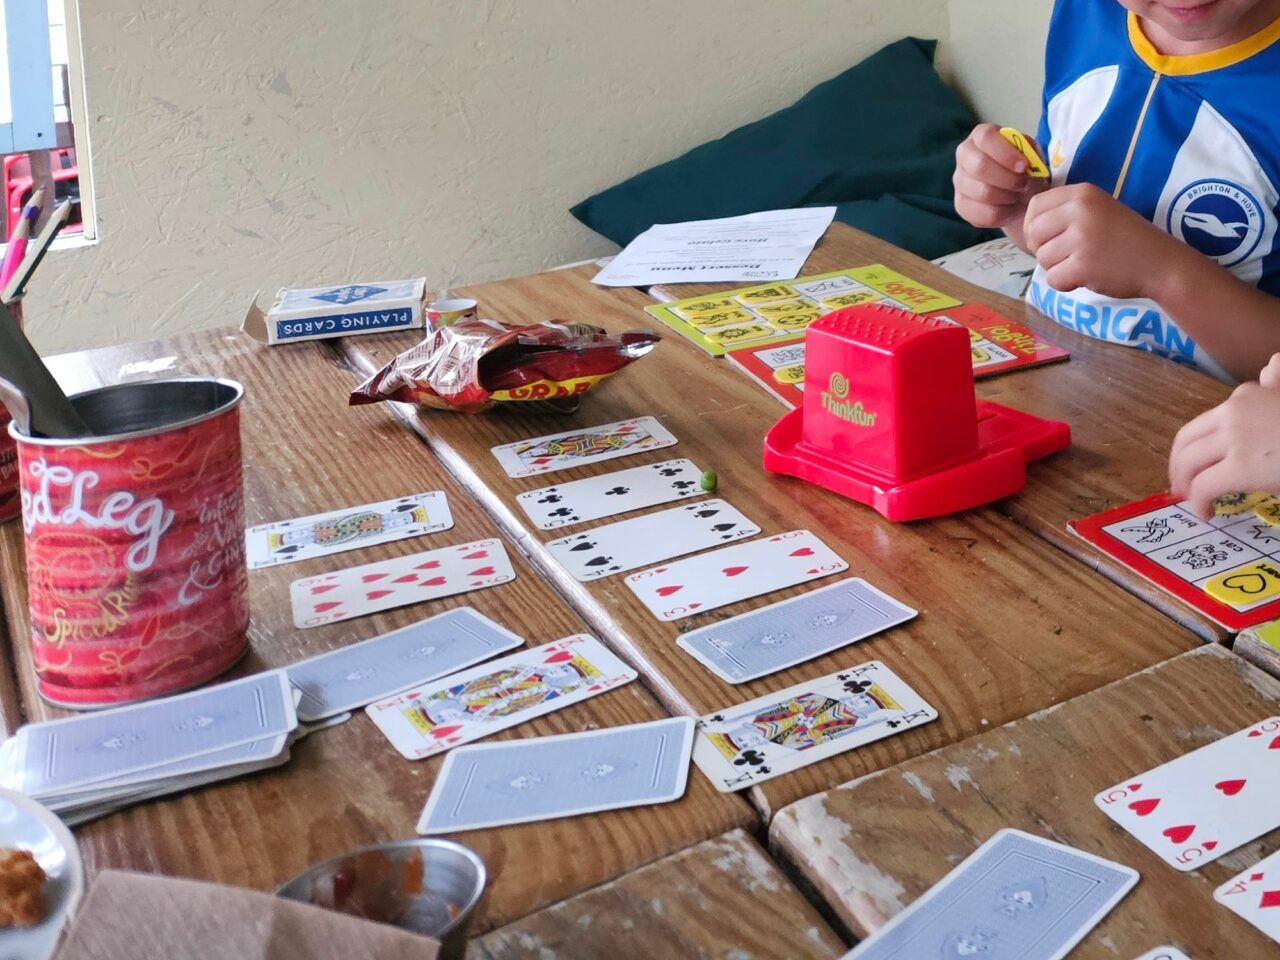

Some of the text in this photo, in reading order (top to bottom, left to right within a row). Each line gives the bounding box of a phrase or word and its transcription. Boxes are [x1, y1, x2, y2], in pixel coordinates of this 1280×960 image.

[1187, 184, 1231, 200] BRIGHTON
[1240, 199, 1257, 218] HOVE
[284, 312, 407, 334] PLAYING CARDS
[1032, 282, 1197, 361] MERICAN
[22, 457, 73, 535] ed
[58, 470, 175, 572] Leg
[1169, 512, 1199, 529] bird
[1219, 539, 1245, 554] cat
[853, 664, 879, 677] K
[903, 709, 930, 724] K
[723, 771, 753, 787] K
[1102, 790, 1128, 804] 5
[1176, 848, 1203, 864] 5
[1223, 880, 1247, 896] 4
